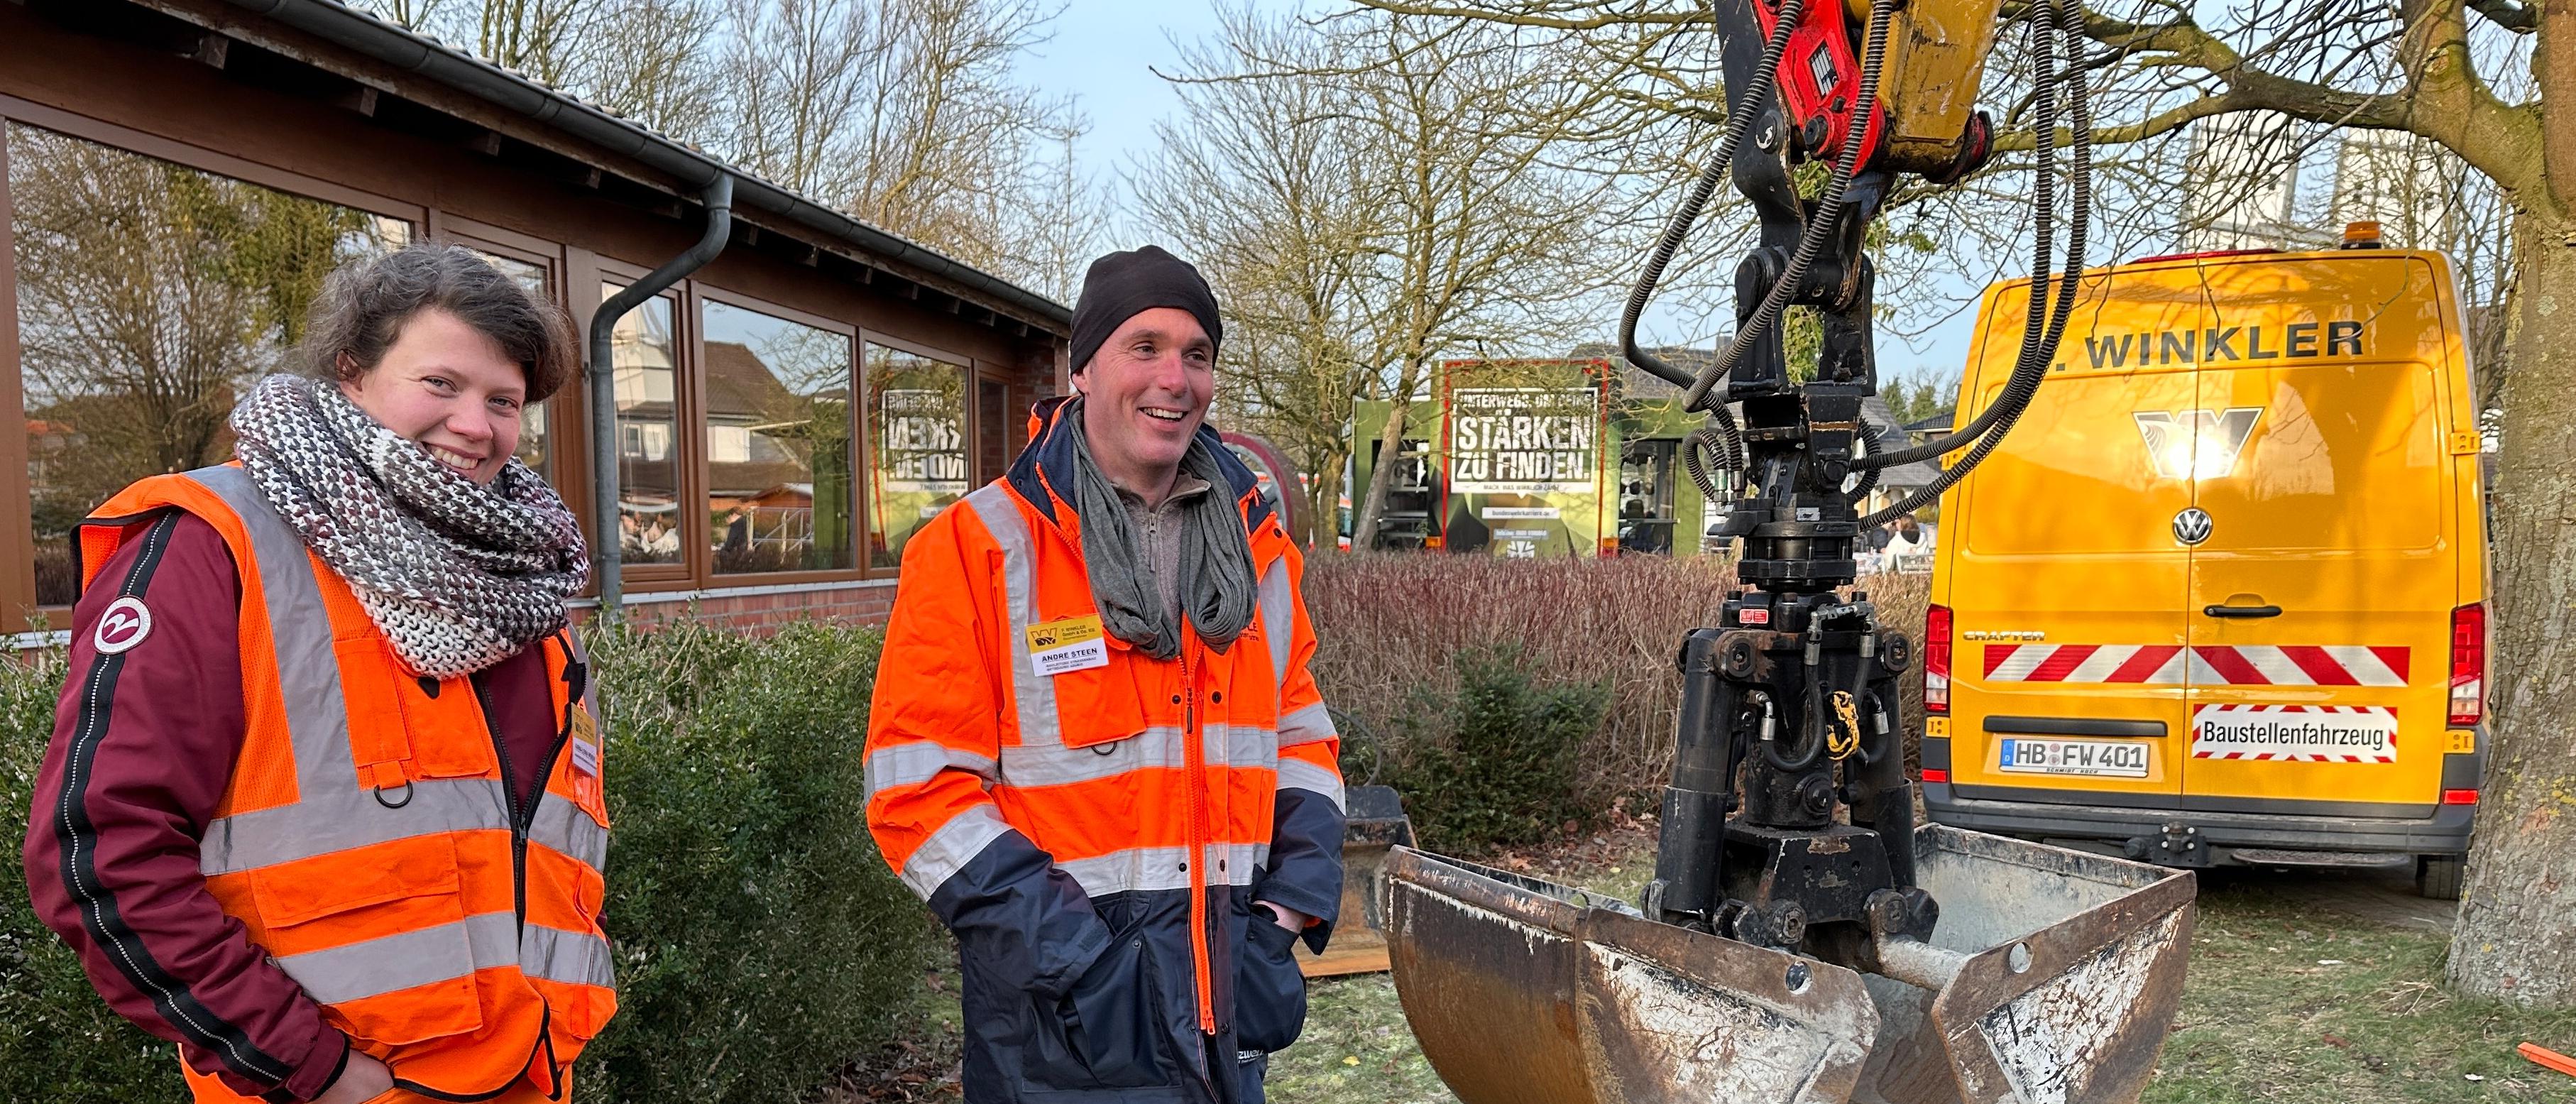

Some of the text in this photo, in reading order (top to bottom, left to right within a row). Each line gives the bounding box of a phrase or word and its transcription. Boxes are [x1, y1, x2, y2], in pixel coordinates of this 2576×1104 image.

[2085, 320, 2364, 368] WINKLER
[1458, 408, 1591, 450] STÄRKEN
[1457, 452, 1590, 480] ZU FINDEN.
[1963, 631, 2045, 640] CRAFTER
[1042, 647, 1097, 662] ANDRE STEEN
[2203, 721, 2384, 751] Baustellenfahrzeug
[2004, 754, 2010, 763] D
[2016, 743, 2143, 767] HB FW 401
